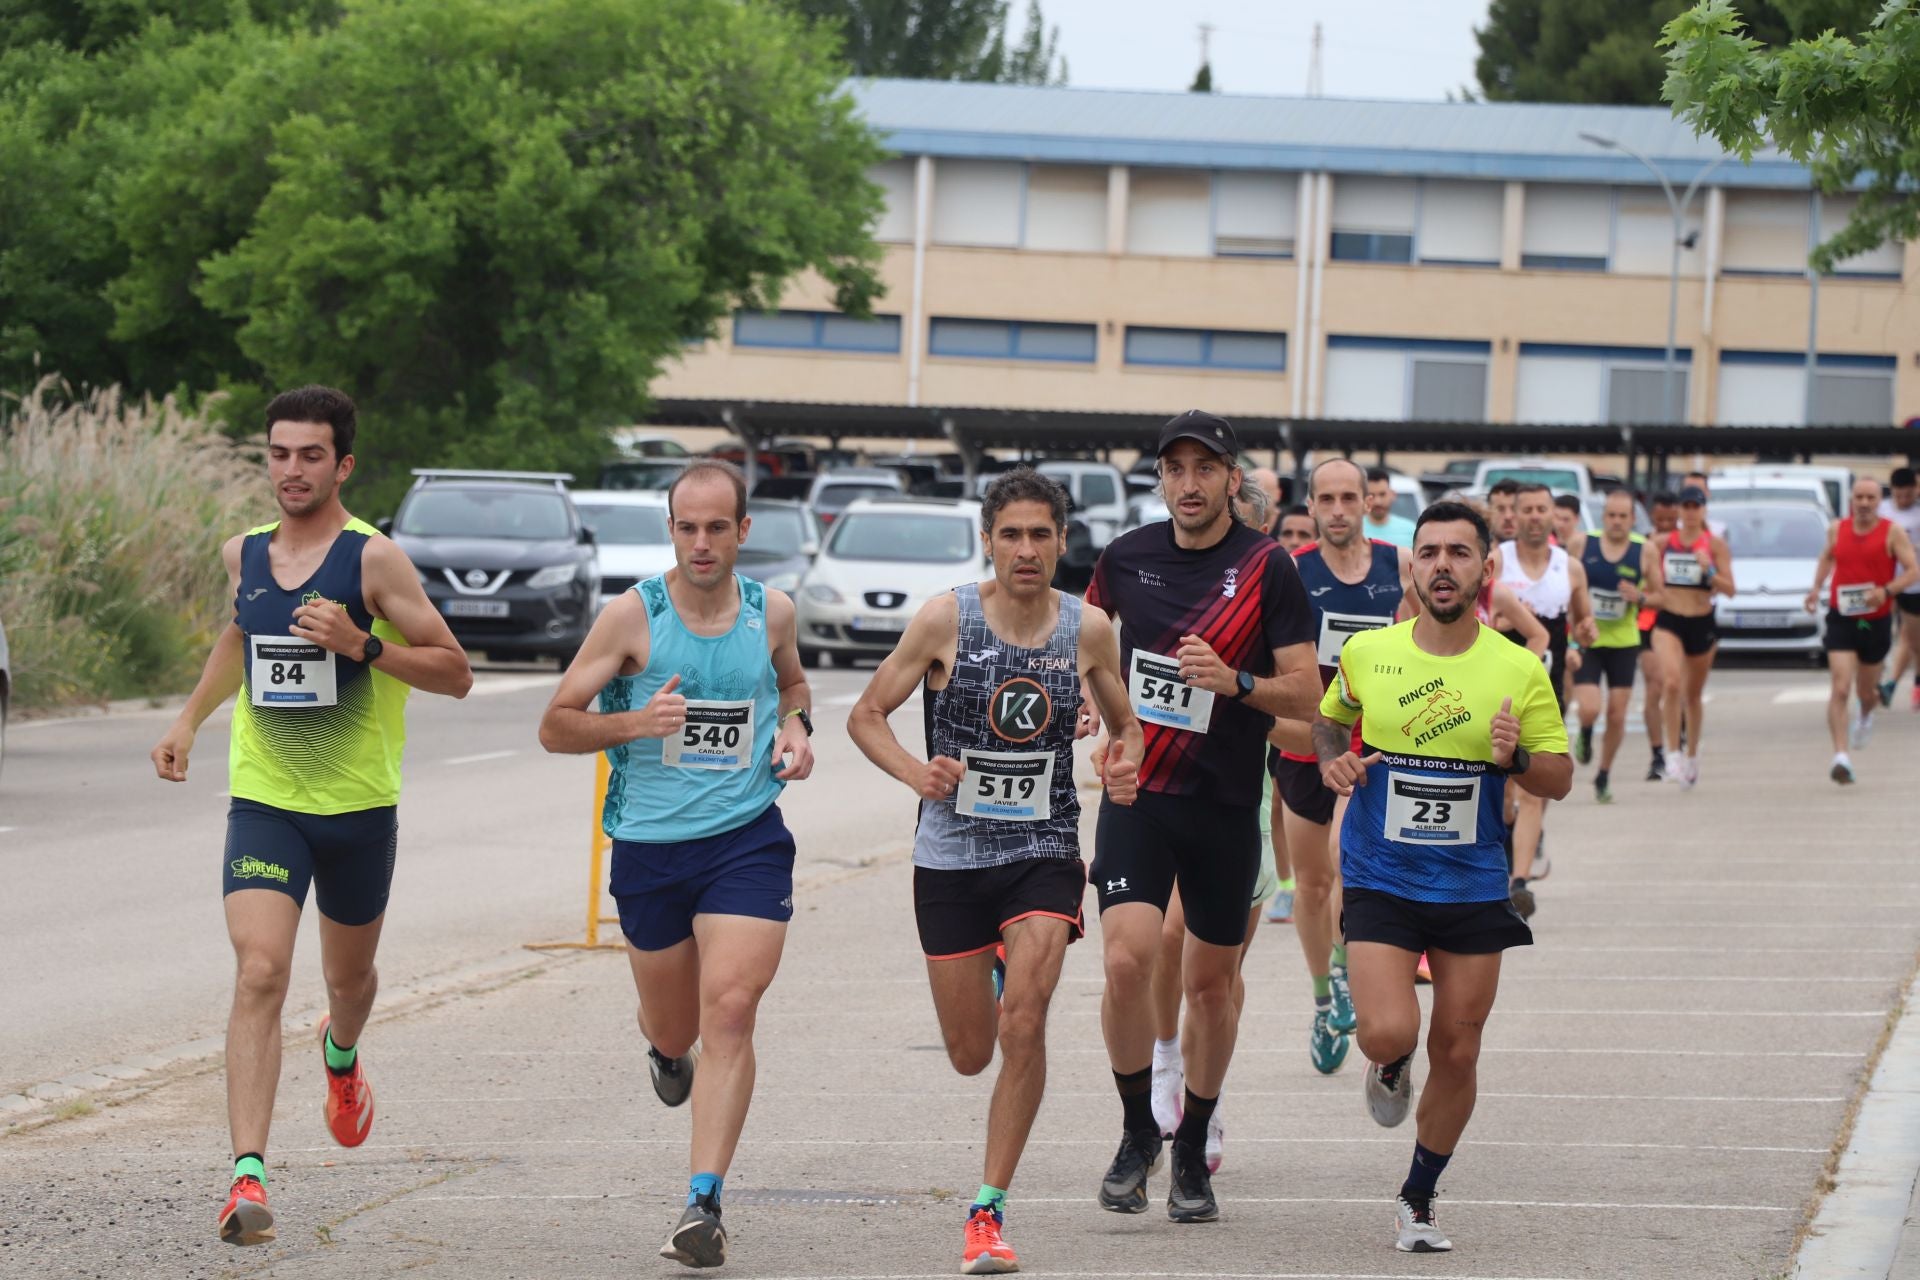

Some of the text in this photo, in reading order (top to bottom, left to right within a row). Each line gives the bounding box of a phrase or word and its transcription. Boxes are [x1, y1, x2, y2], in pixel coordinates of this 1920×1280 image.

[271, 663, 305, 684] 84
[1028, 658, 1070, 669] K-TEAM
[1375, 664, 1403, 675] GOBIK
[1141, 678, 1192, 708] 541
[1398, 677, 1444, 708] RINCON
[1152, 704, 1175, 712] JAVIER
[684, 725, 740, 748] 540
[1414, 711, 1471, 748] ATLETISMO
[1467, 764, 1486, 772] RIOJA
[978, 775, 1035, 799] 519
[1412, 802, 1452, 824] 23
